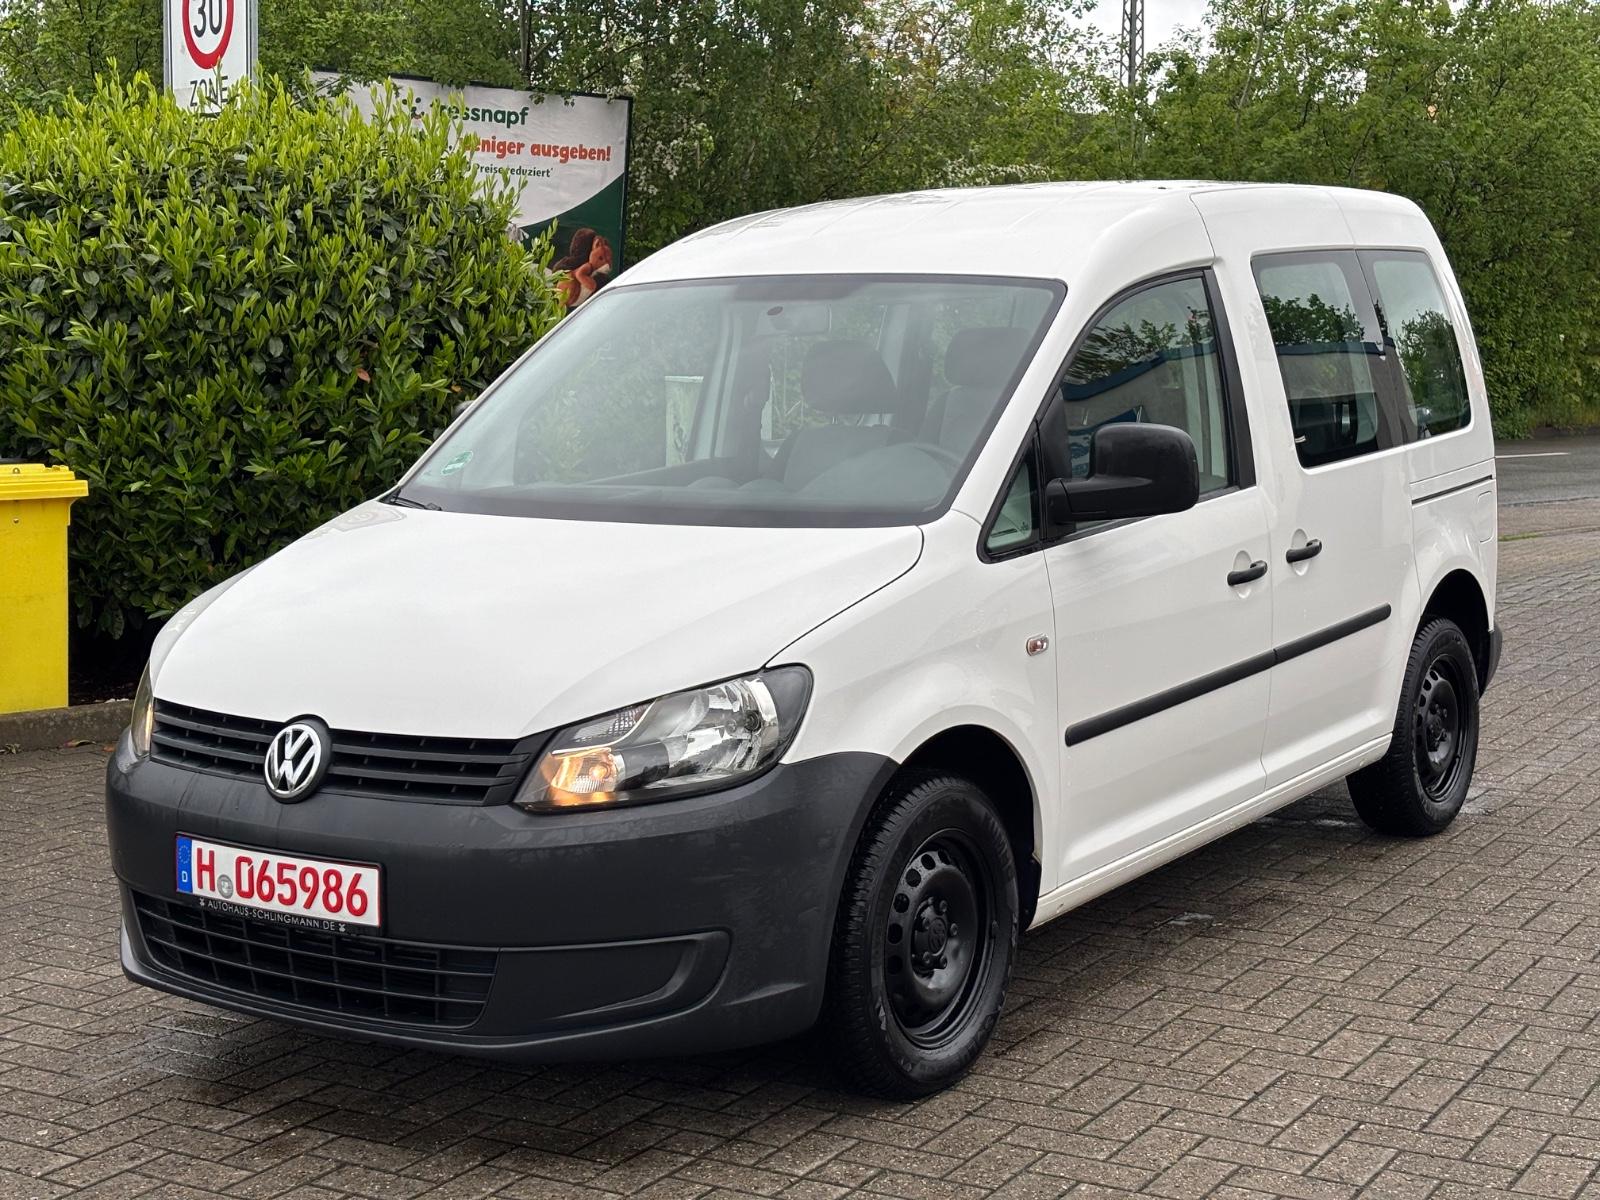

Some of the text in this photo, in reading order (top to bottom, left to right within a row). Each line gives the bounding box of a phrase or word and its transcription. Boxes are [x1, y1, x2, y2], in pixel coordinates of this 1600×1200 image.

[193, 0, 223, 38] 30
[189, 75, 229, 108] ZONE
[429, 100, 530, 129] ressnapf
[460, 135, 612, 164] niger ausgeben!
[505, 166, 554, 178] eduziert
[181, 870, 188, 883] D
[196, 847, 216, 892] H
[235, 855, 369, 917] 065986
